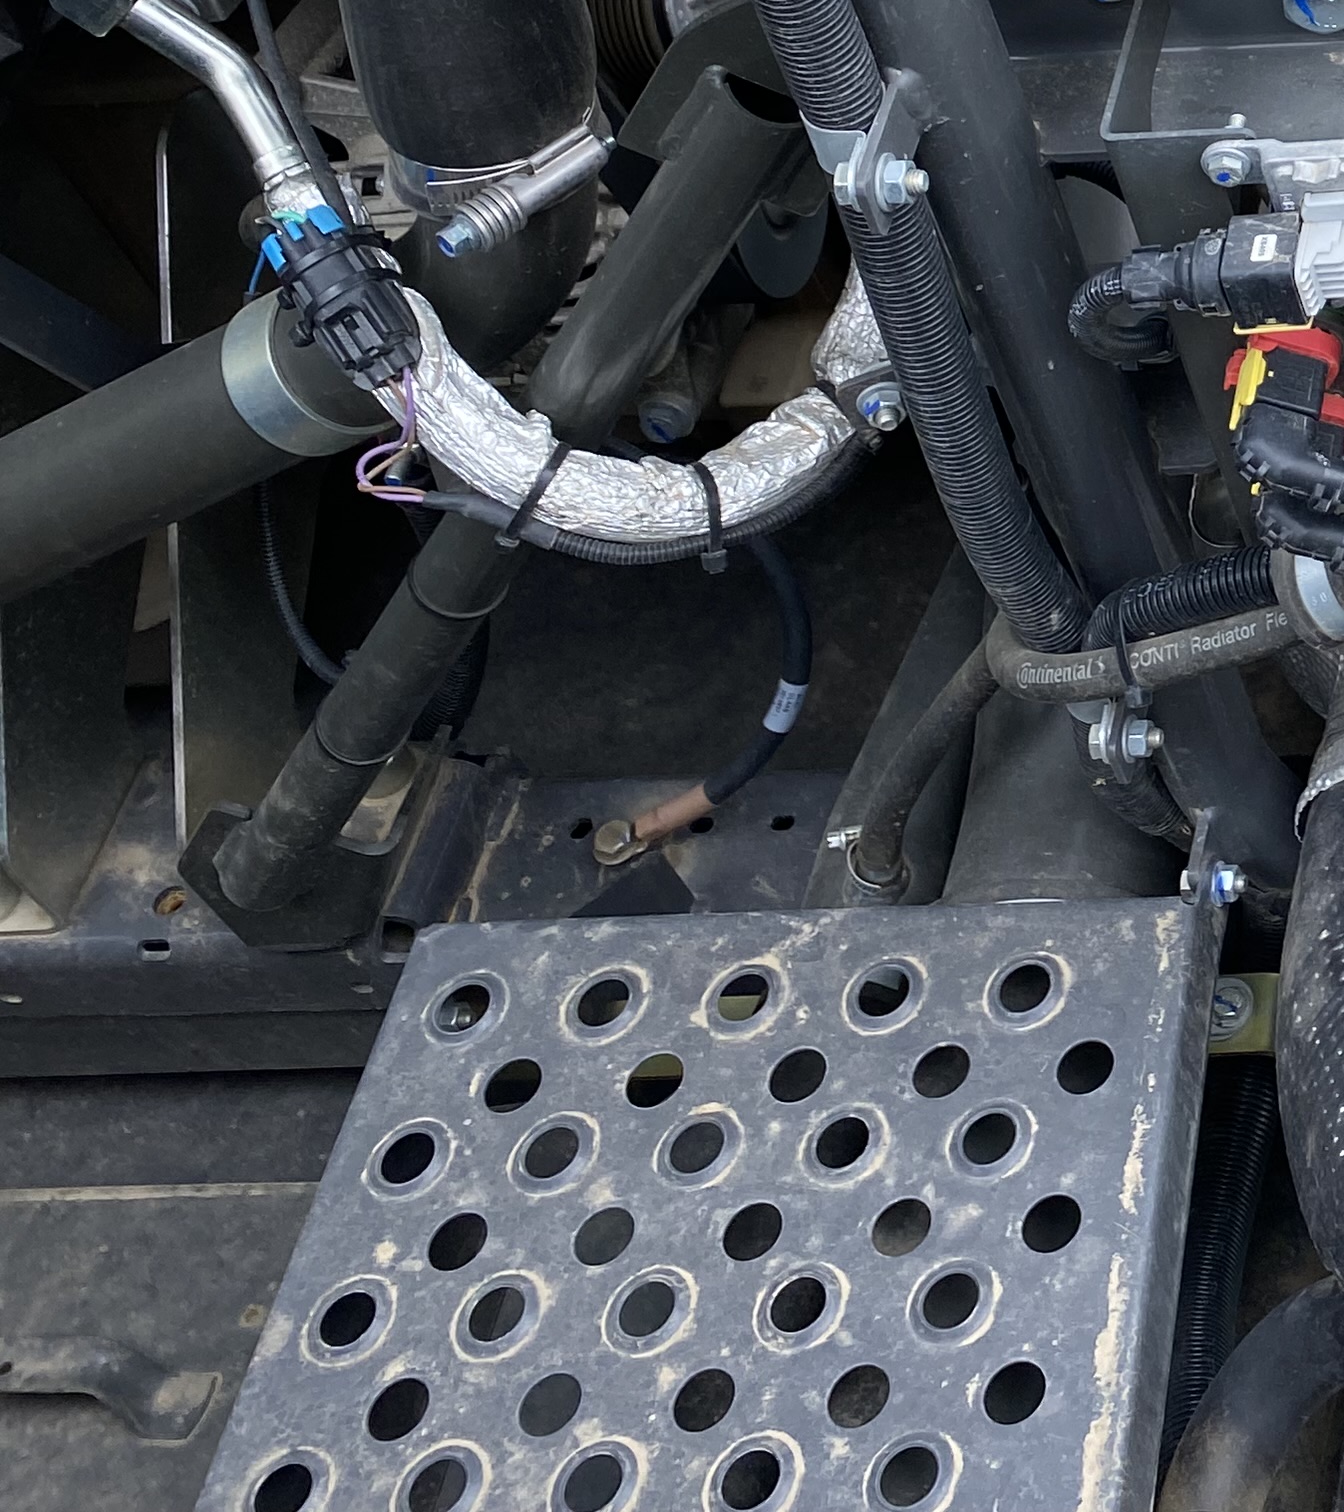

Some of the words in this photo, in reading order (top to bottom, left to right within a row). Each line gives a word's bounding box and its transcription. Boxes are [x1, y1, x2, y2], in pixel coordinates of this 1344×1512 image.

[1016, 659, 1092, 688] Continental
[1190, 623, 1257, 656] Radiator
[1266, 610, 1289, 633] Fle
